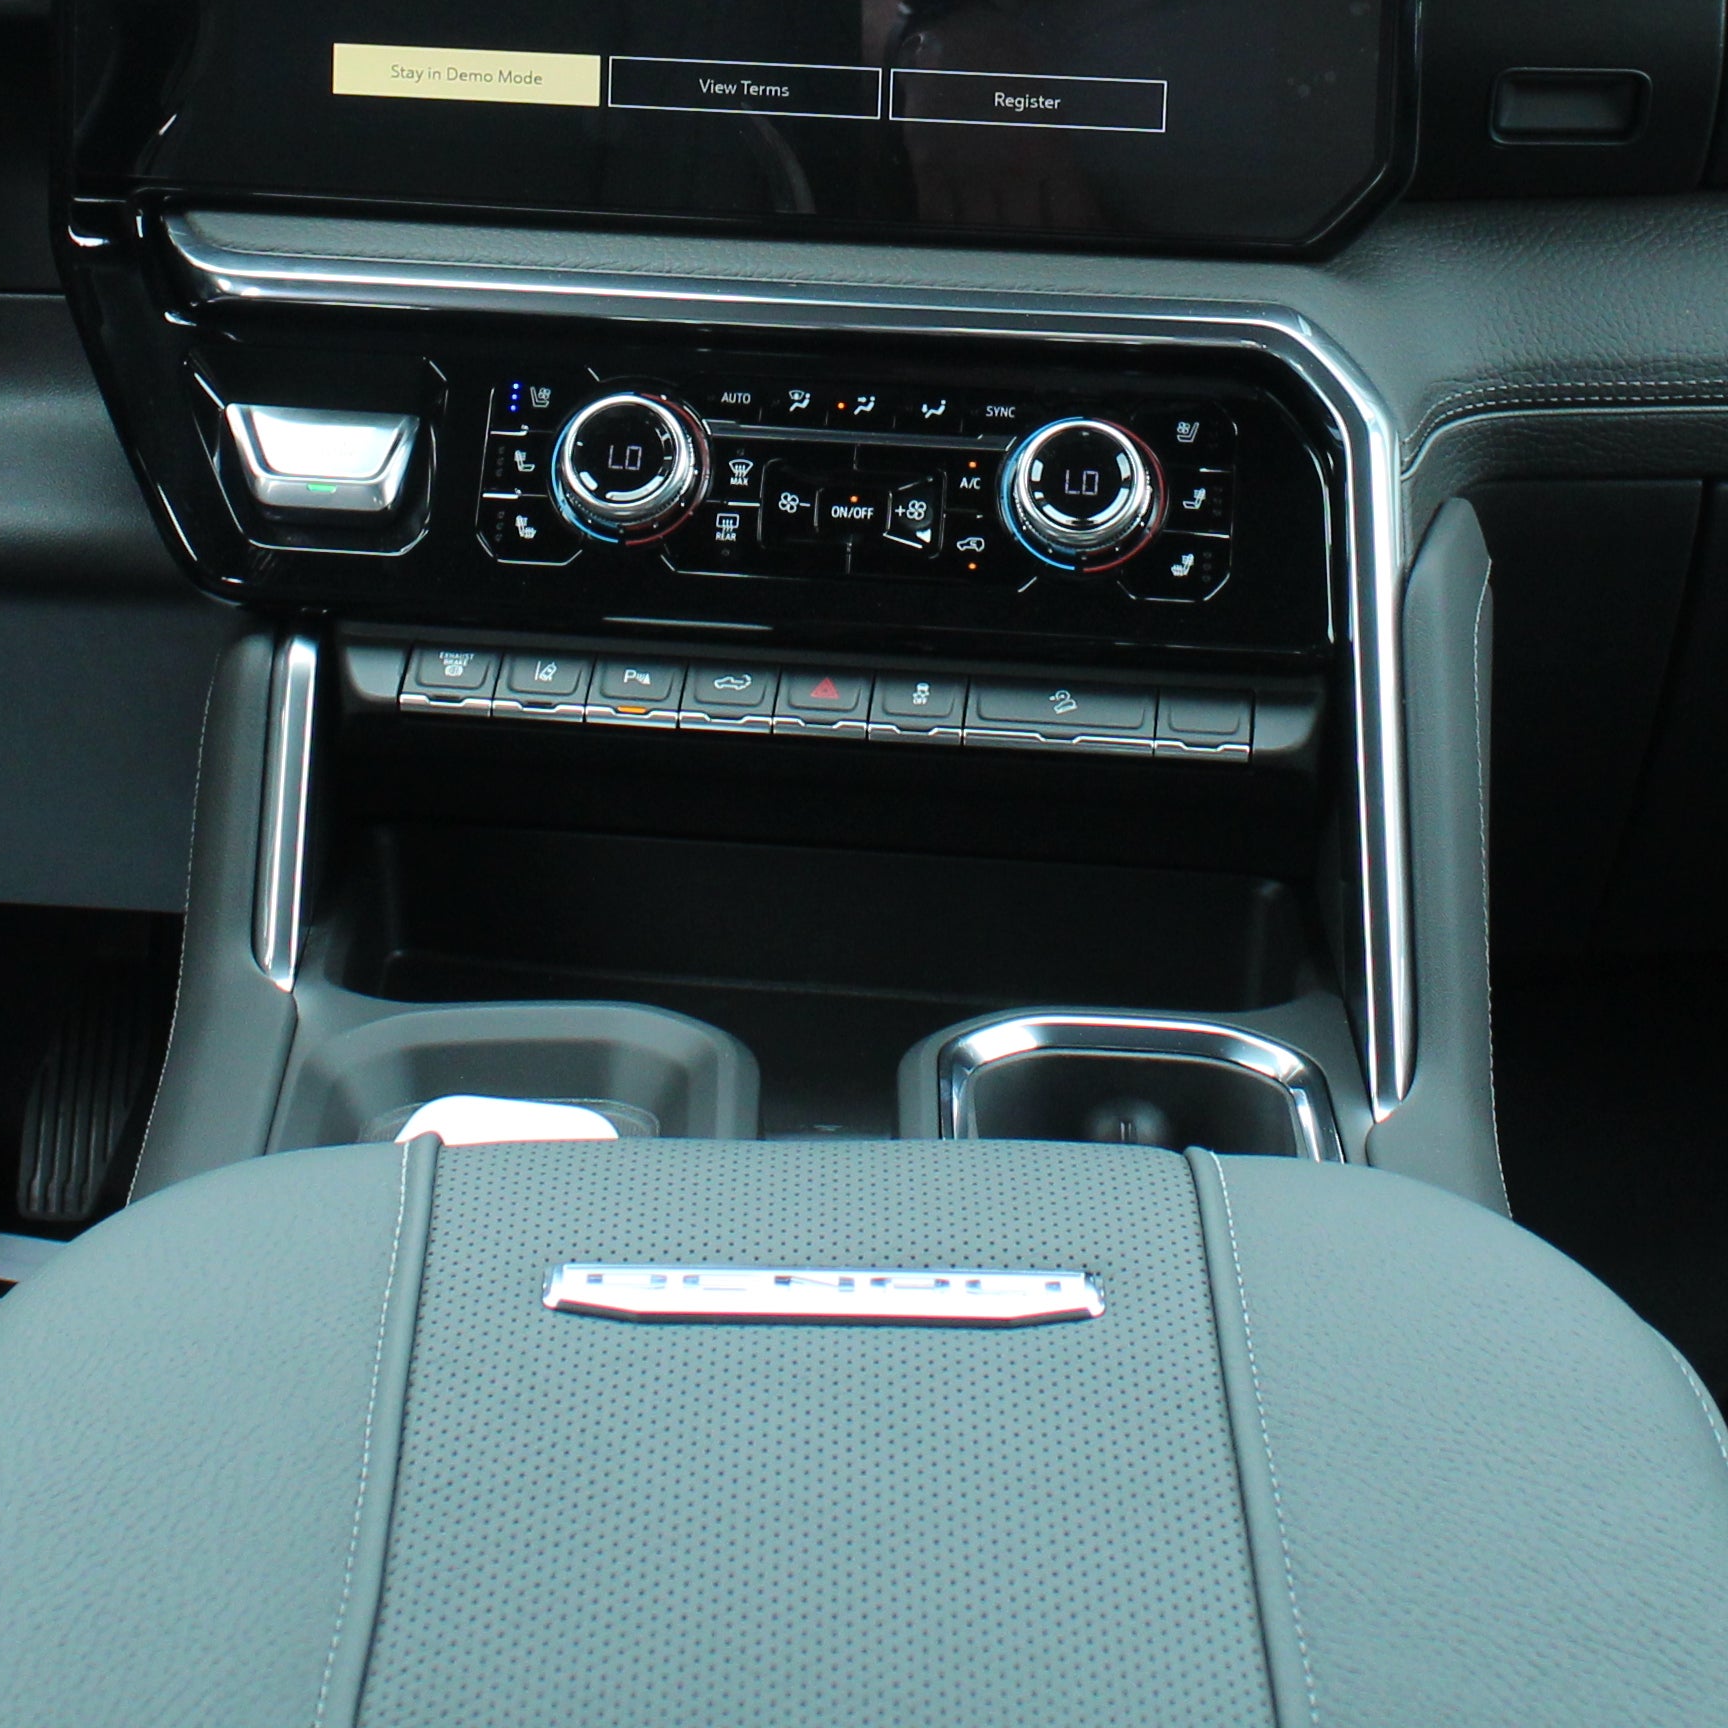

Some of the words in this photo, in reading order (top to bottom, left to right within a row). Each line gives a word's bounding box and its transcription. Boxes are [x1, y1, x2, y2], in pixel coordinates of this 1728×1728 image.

[390, 63, 425, 85] Stay
[427, 66, 442, 81] in
[445, 67, 494, 83] Demo
[497, 69, 544, 86] Mode
[698, 77, 738, 96] View
[740, 80, 790, 98] Terms
[994, 91, 1062, 113] Register
[721, 391, 752, 405] AUTO
[985, 405, 1016, 419] SYNC
[608, 444, 643, 471] LO
[730, 475, 750, 487] MAX
[959, 476, 982, 490] A/C
[1064, 469, 1100, 496] LO
[831, 504, 875, 520] ON/OFF
[715, 531, 738, 543] REAR
